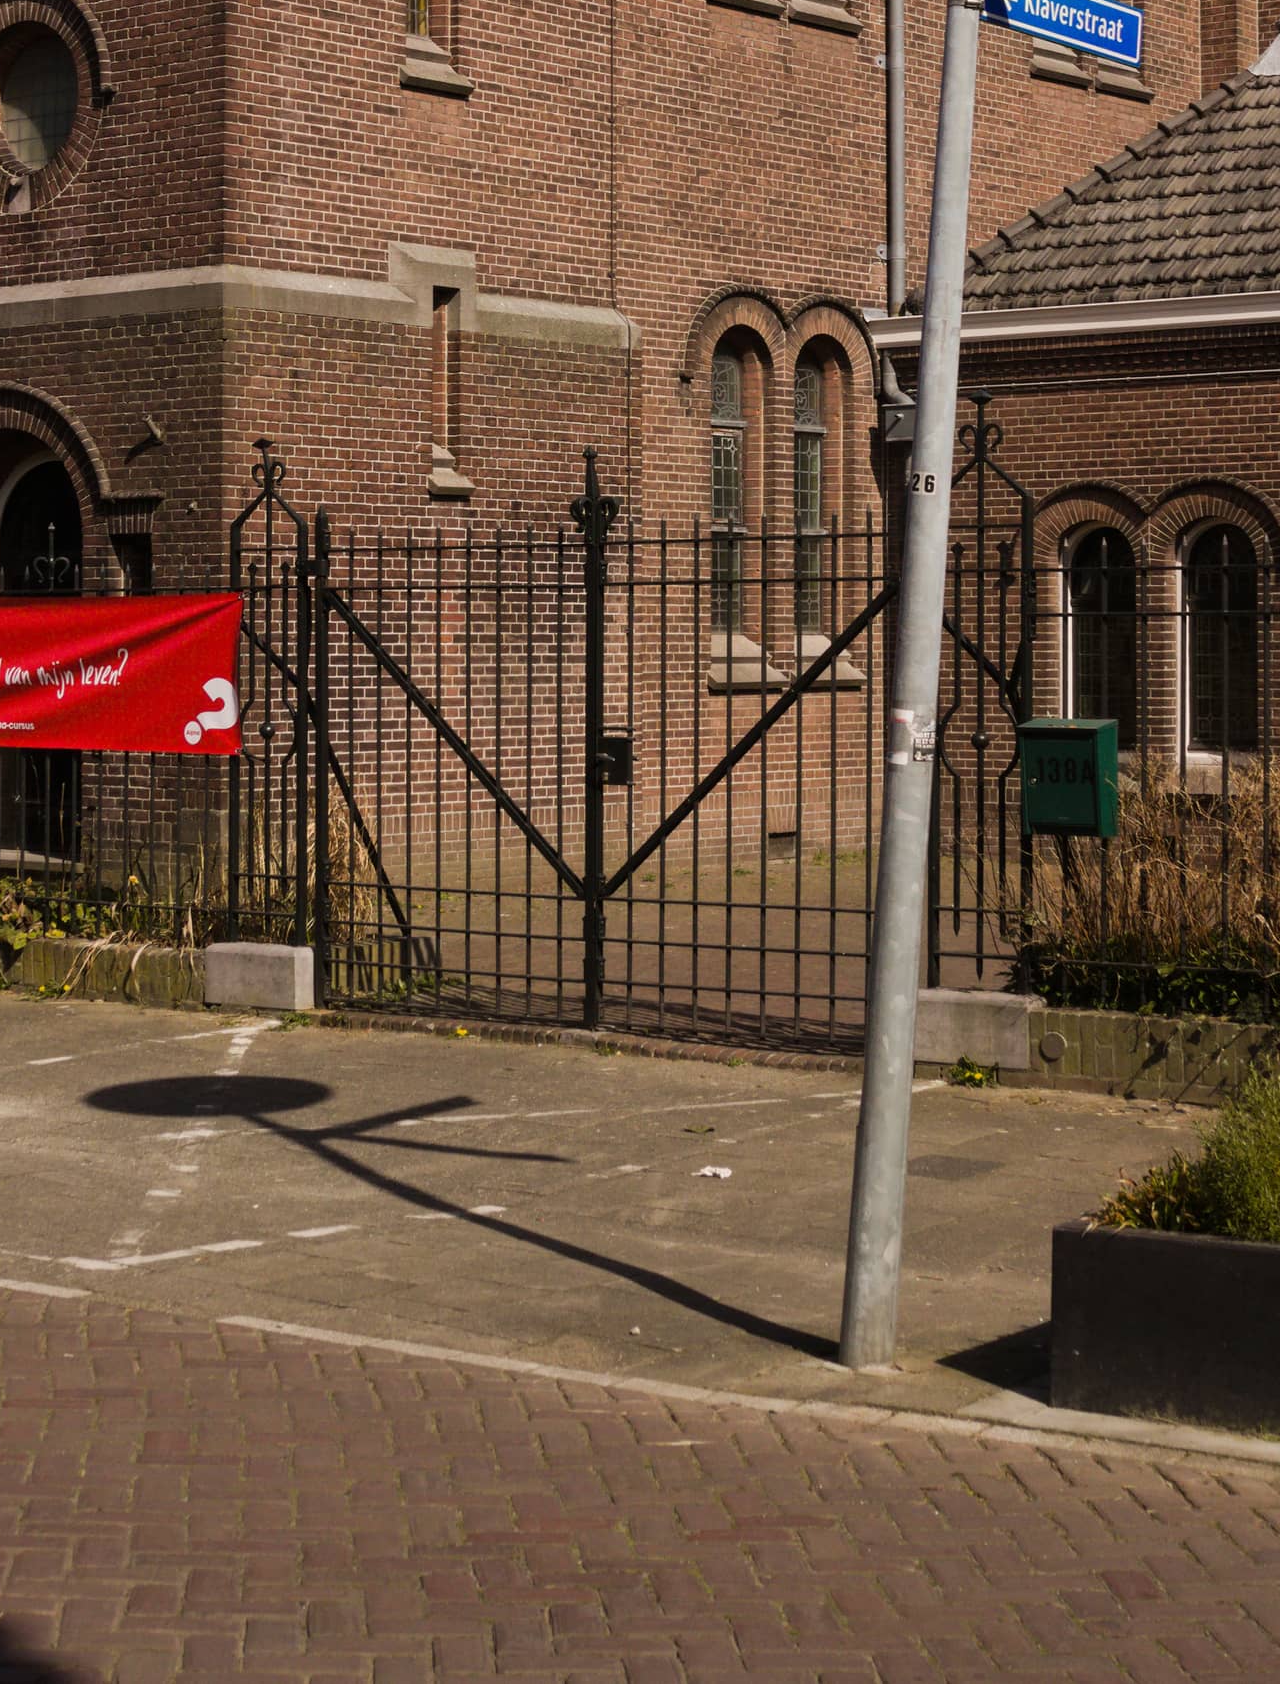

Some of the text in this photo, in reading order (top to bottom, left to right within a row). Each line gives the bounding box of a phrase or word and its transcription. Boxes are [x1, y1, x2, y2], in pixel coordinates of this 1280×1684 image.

[911, 473, 935, 493] 26
[5, 667, 31, 686] van
[37, 660, 75, 699] mijn
[79, 648, 129, 686] leven?
[1038, 757, 1095, 784] 138A
